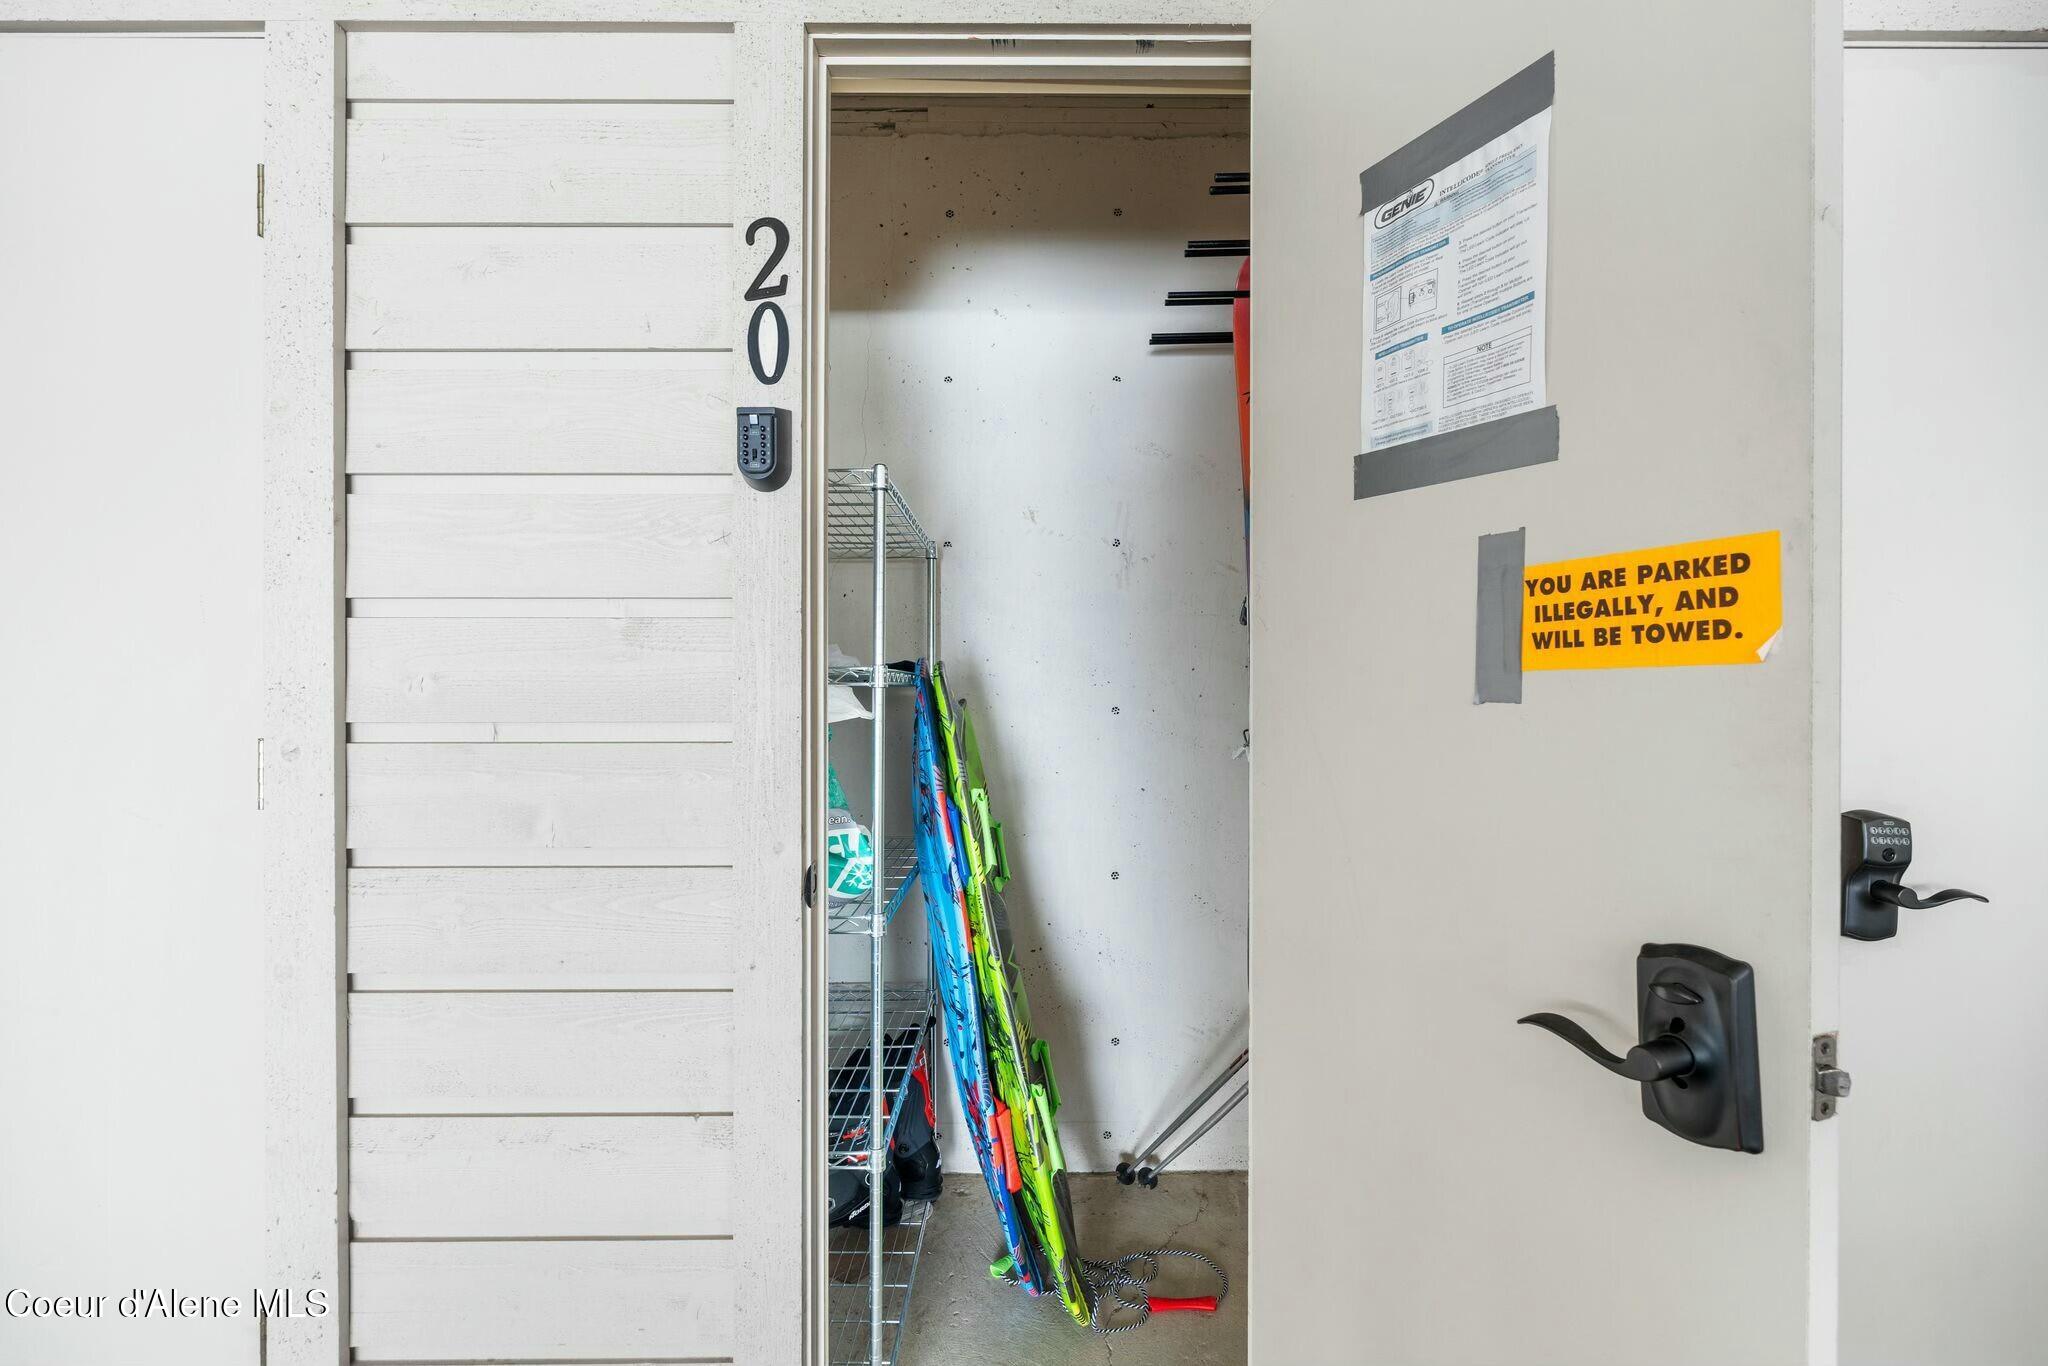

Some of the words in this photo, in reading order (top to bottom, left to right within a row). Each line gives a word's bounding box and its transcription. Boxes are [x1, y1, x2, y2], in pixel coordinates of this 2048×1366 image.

[1381, 187, 1428, 222] GENIE
[744, 217, 790, 385] 20
[1476, 342, 1492, 353] NOTE
[1525, 575, 1571, 597] YOU
[1581, 567, 1627, 592] ARE
[1637, 552, 1751, 585] PARKED
[1534, 593, 1663, 623] ILLEGALLY,
[1675, 586, 1739, 611] AND
[1532, 629, 1585, 650] WILL
[1594, 625, 1621, 647] BE
[1631, 619, 1743, 645] TOWED.
